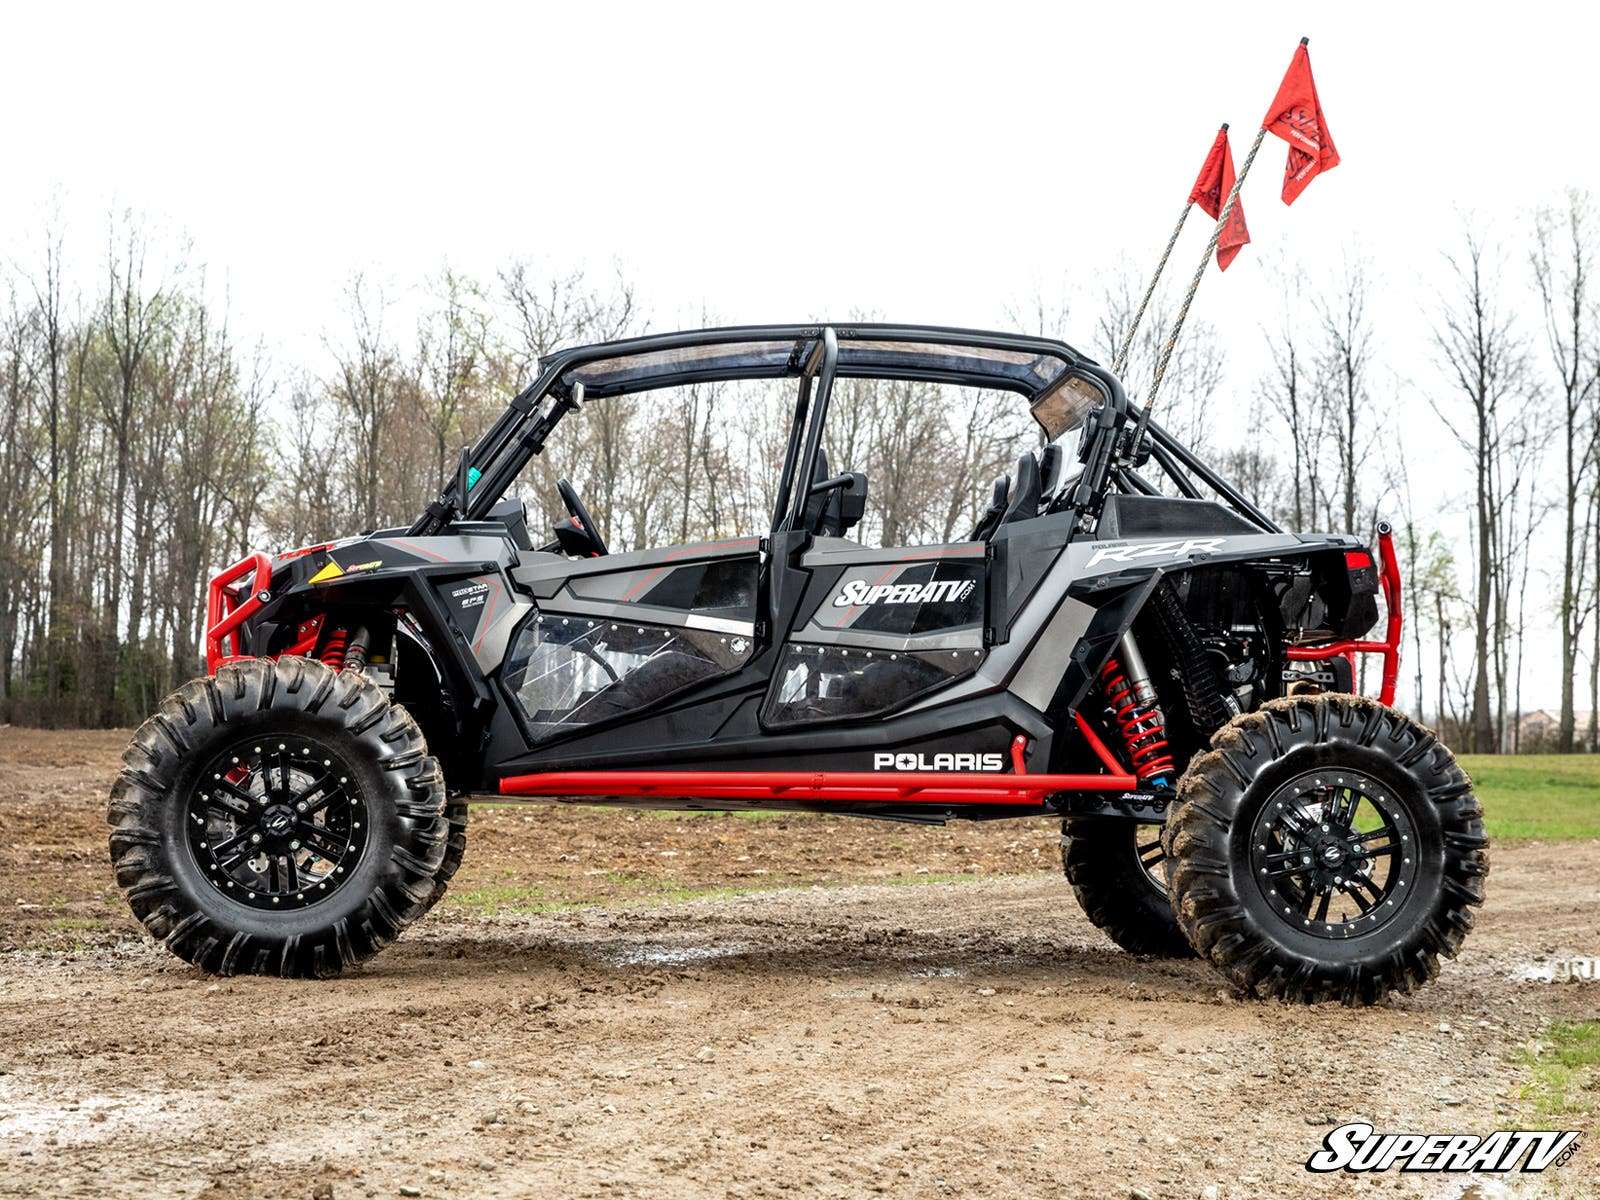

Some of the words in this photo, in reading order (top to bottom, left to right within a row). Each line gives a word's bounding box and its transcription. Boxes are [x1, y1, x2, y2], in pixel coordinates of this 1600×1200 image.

[1084, 537, 1227, 570] RZR
[834, 579, 971, 607] SUPERATV
[874, 753, 1003, 771] POLARIS
